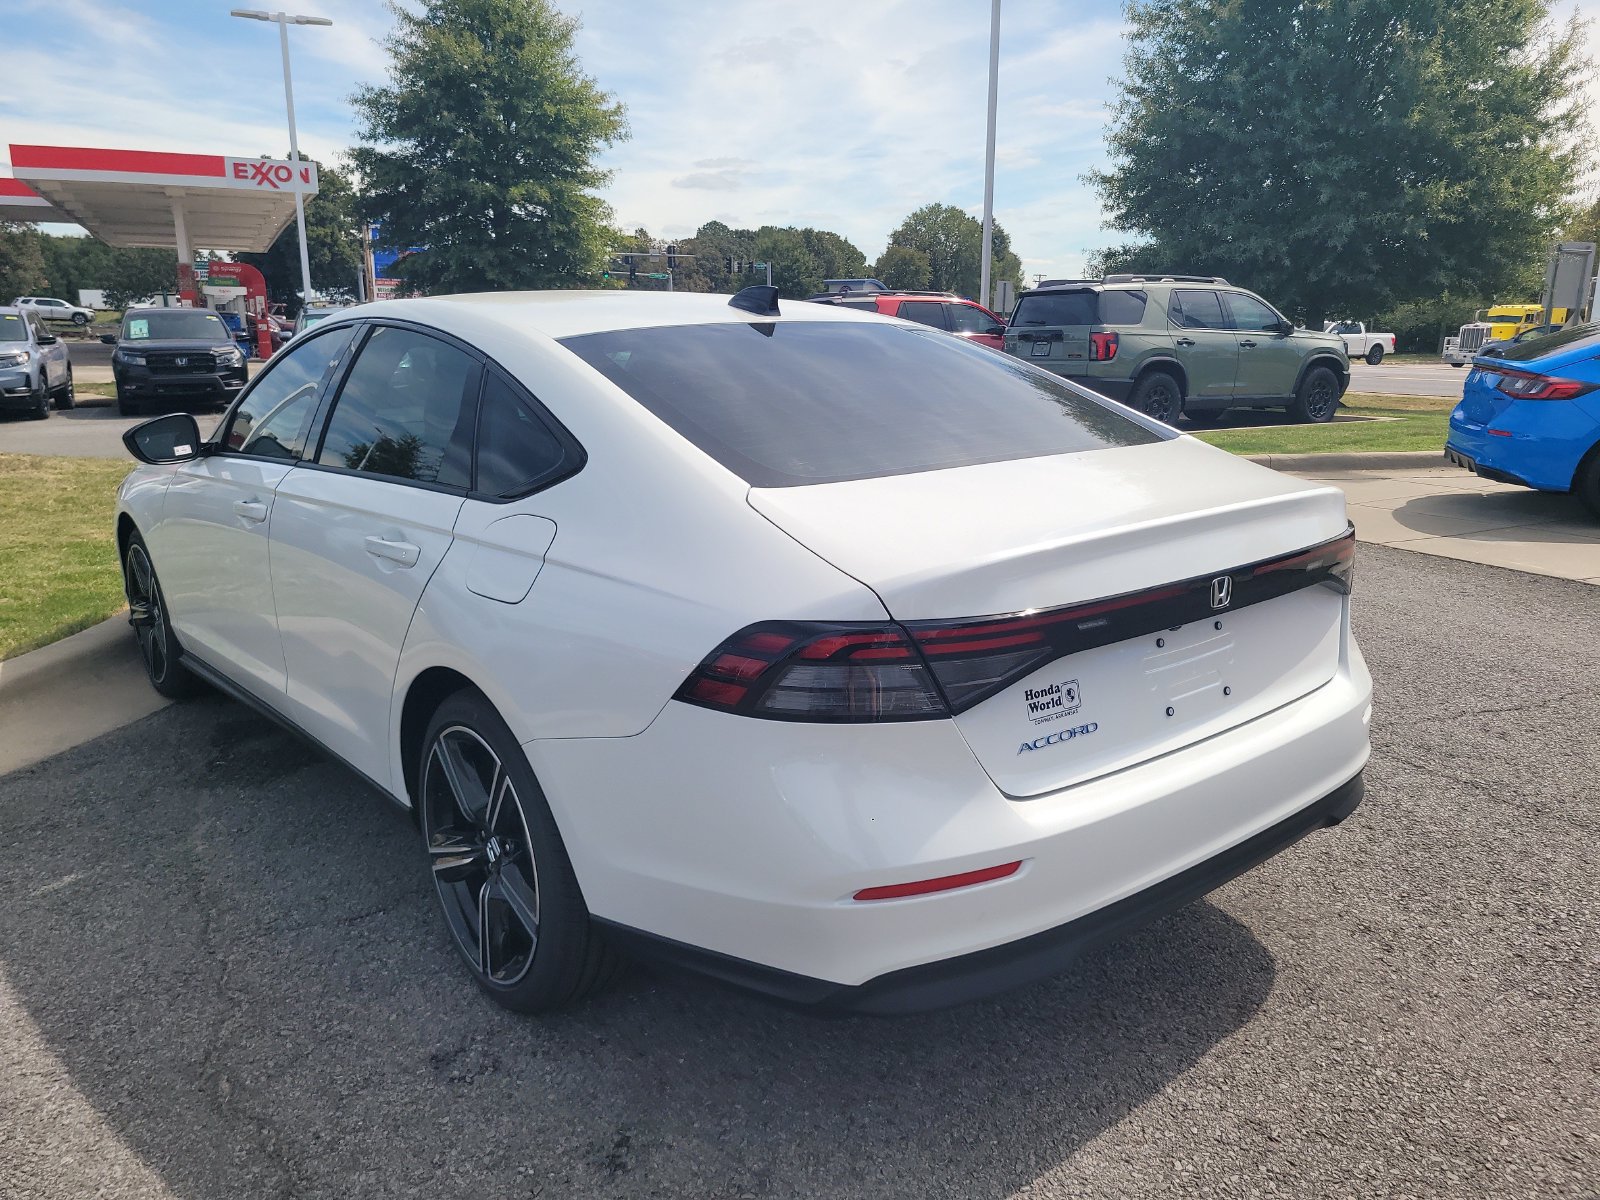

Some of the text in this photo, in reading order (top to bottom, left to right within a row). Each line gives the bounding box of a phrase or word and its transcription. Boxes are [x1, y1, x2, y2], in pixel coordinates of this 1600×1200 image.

[233, 161, 310, 188] EXXON
[1024, 684, 1061, 701] Honda
[1028, 696, 1062, 713] World
[1017, 722, 1098, 756] ACCORD
